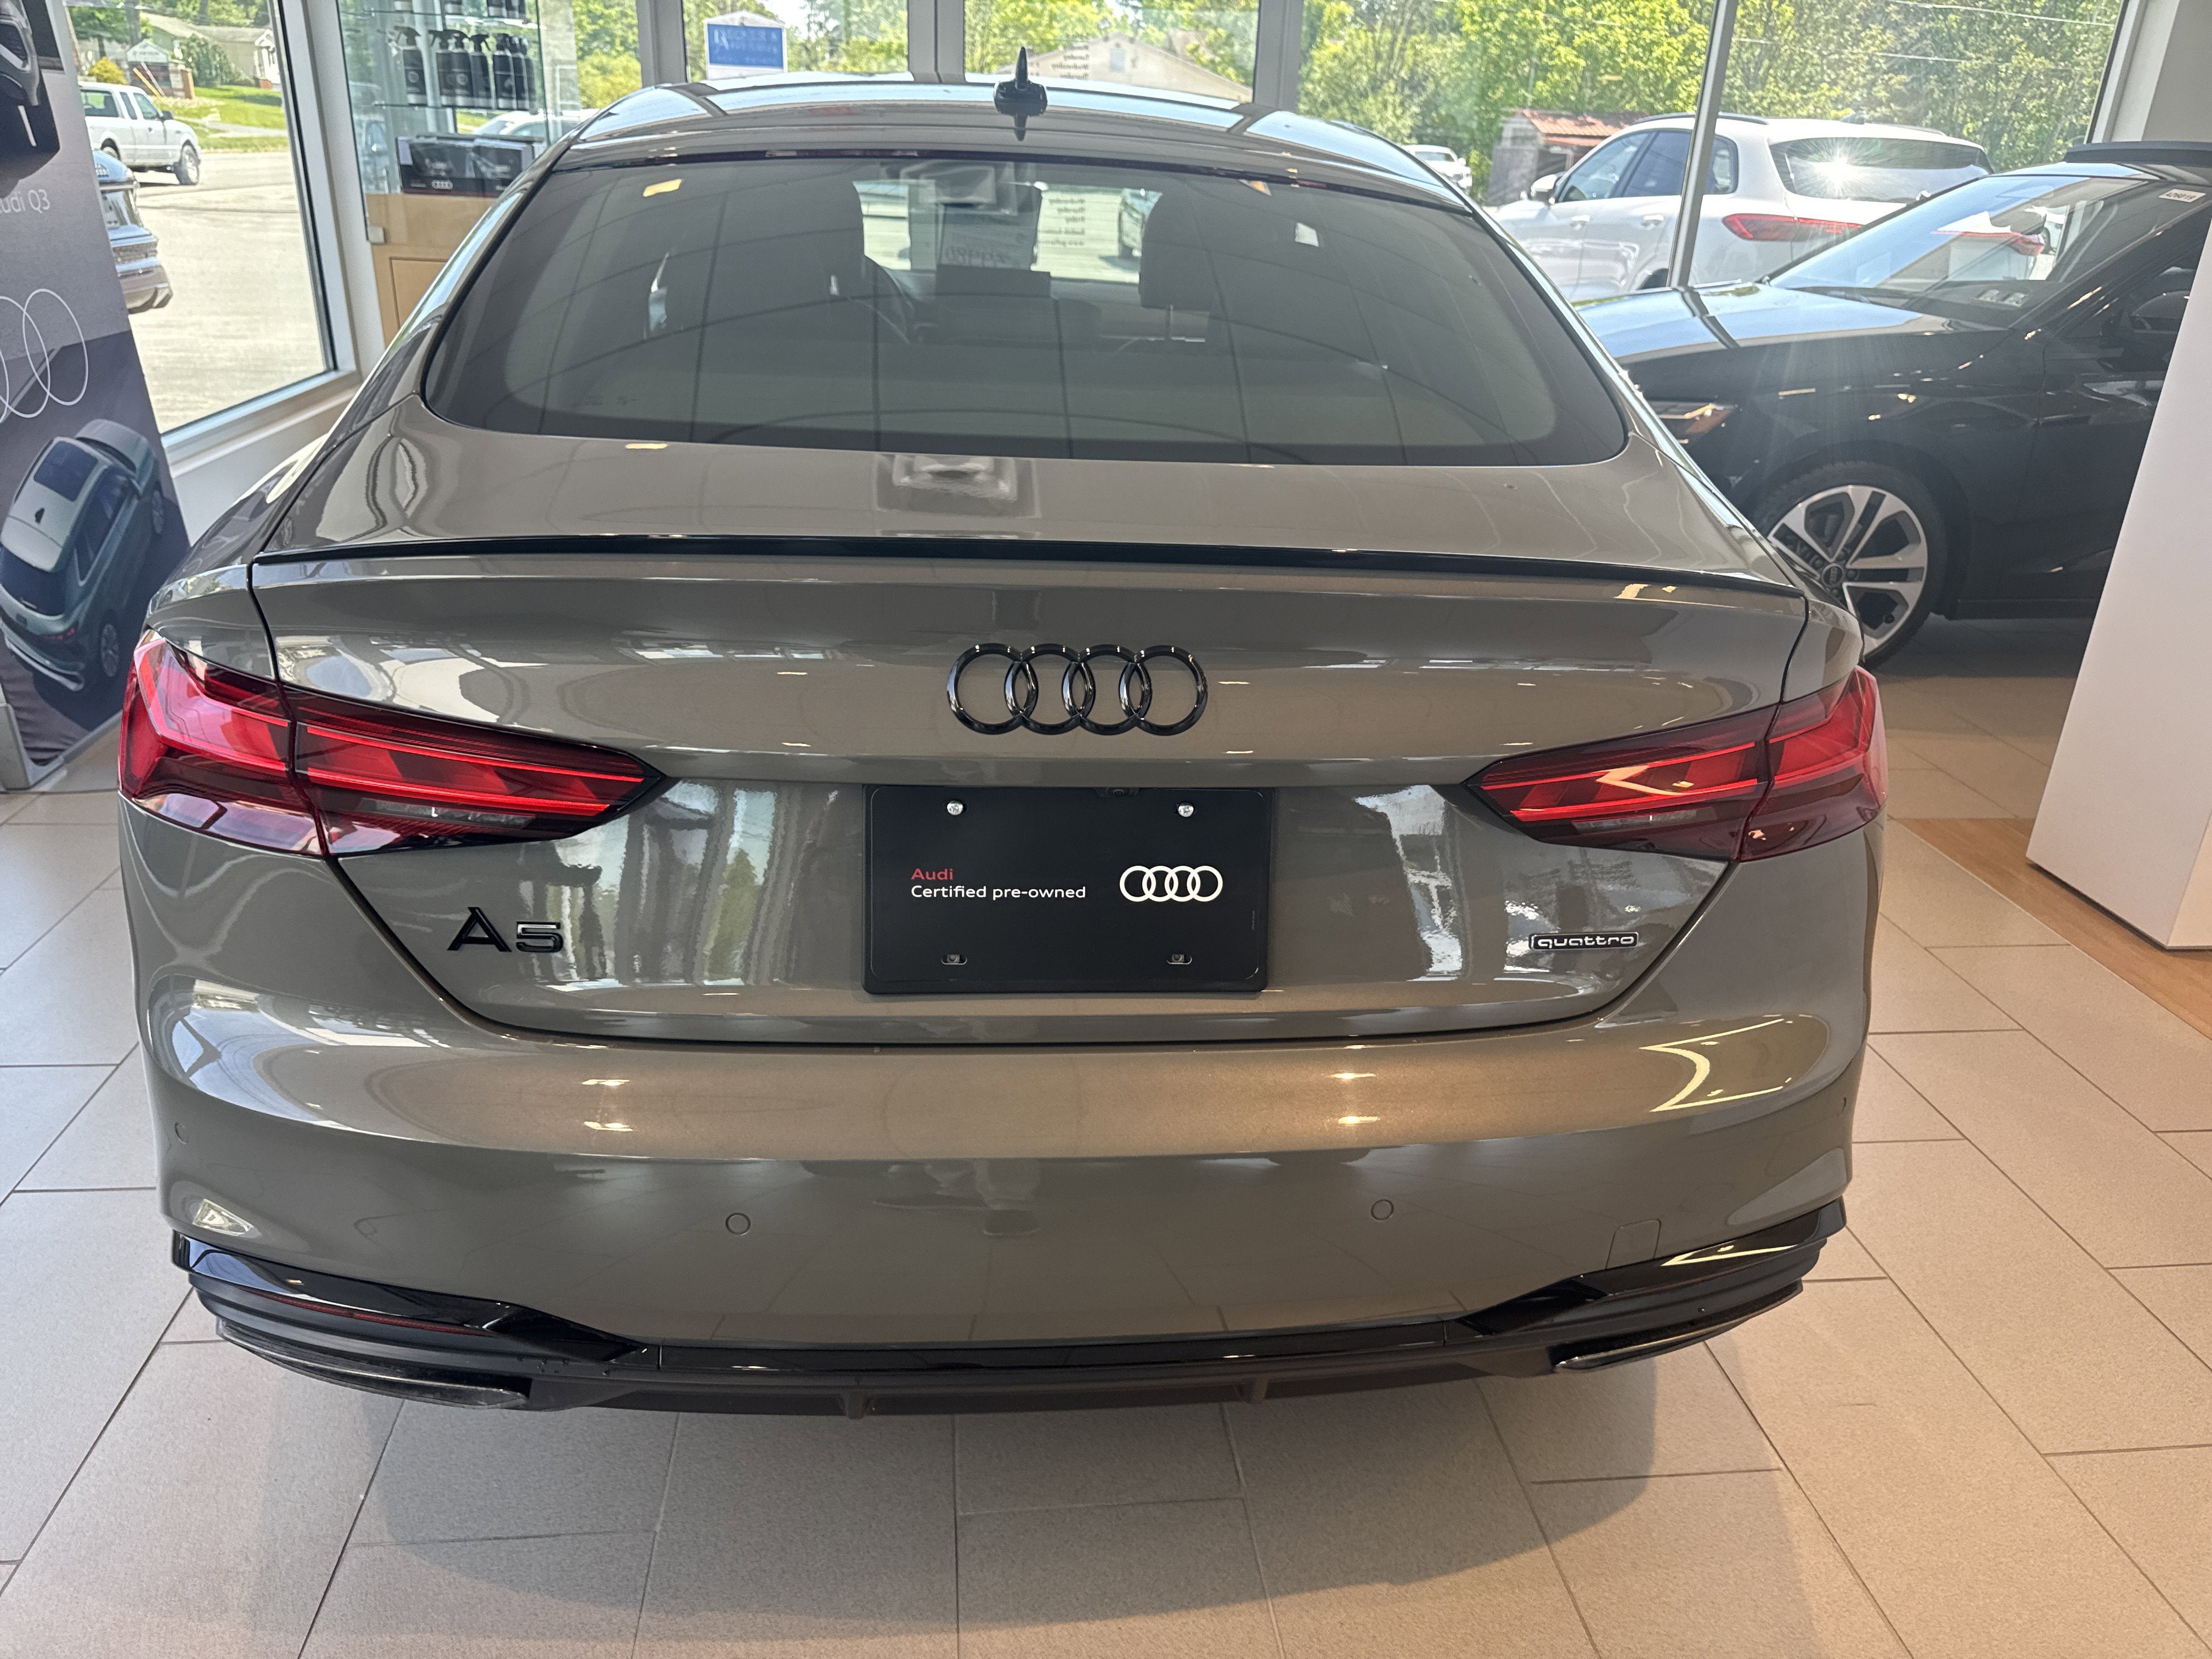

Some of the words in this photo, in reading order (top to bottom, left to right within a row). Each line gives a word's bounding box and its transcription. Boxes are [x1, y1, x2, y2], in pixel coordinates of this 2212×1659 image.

[0, 191, 26, 213] udi
[28, 189, 50, 213] Q3
[911, 868, 953, 881] Audi
[911, 885, 986, 898] Certified
[992, 886, 1086, 900] pre-owned
[447, 907, 563, 953] A5
[1538, 936, 1634, 949] quattro
